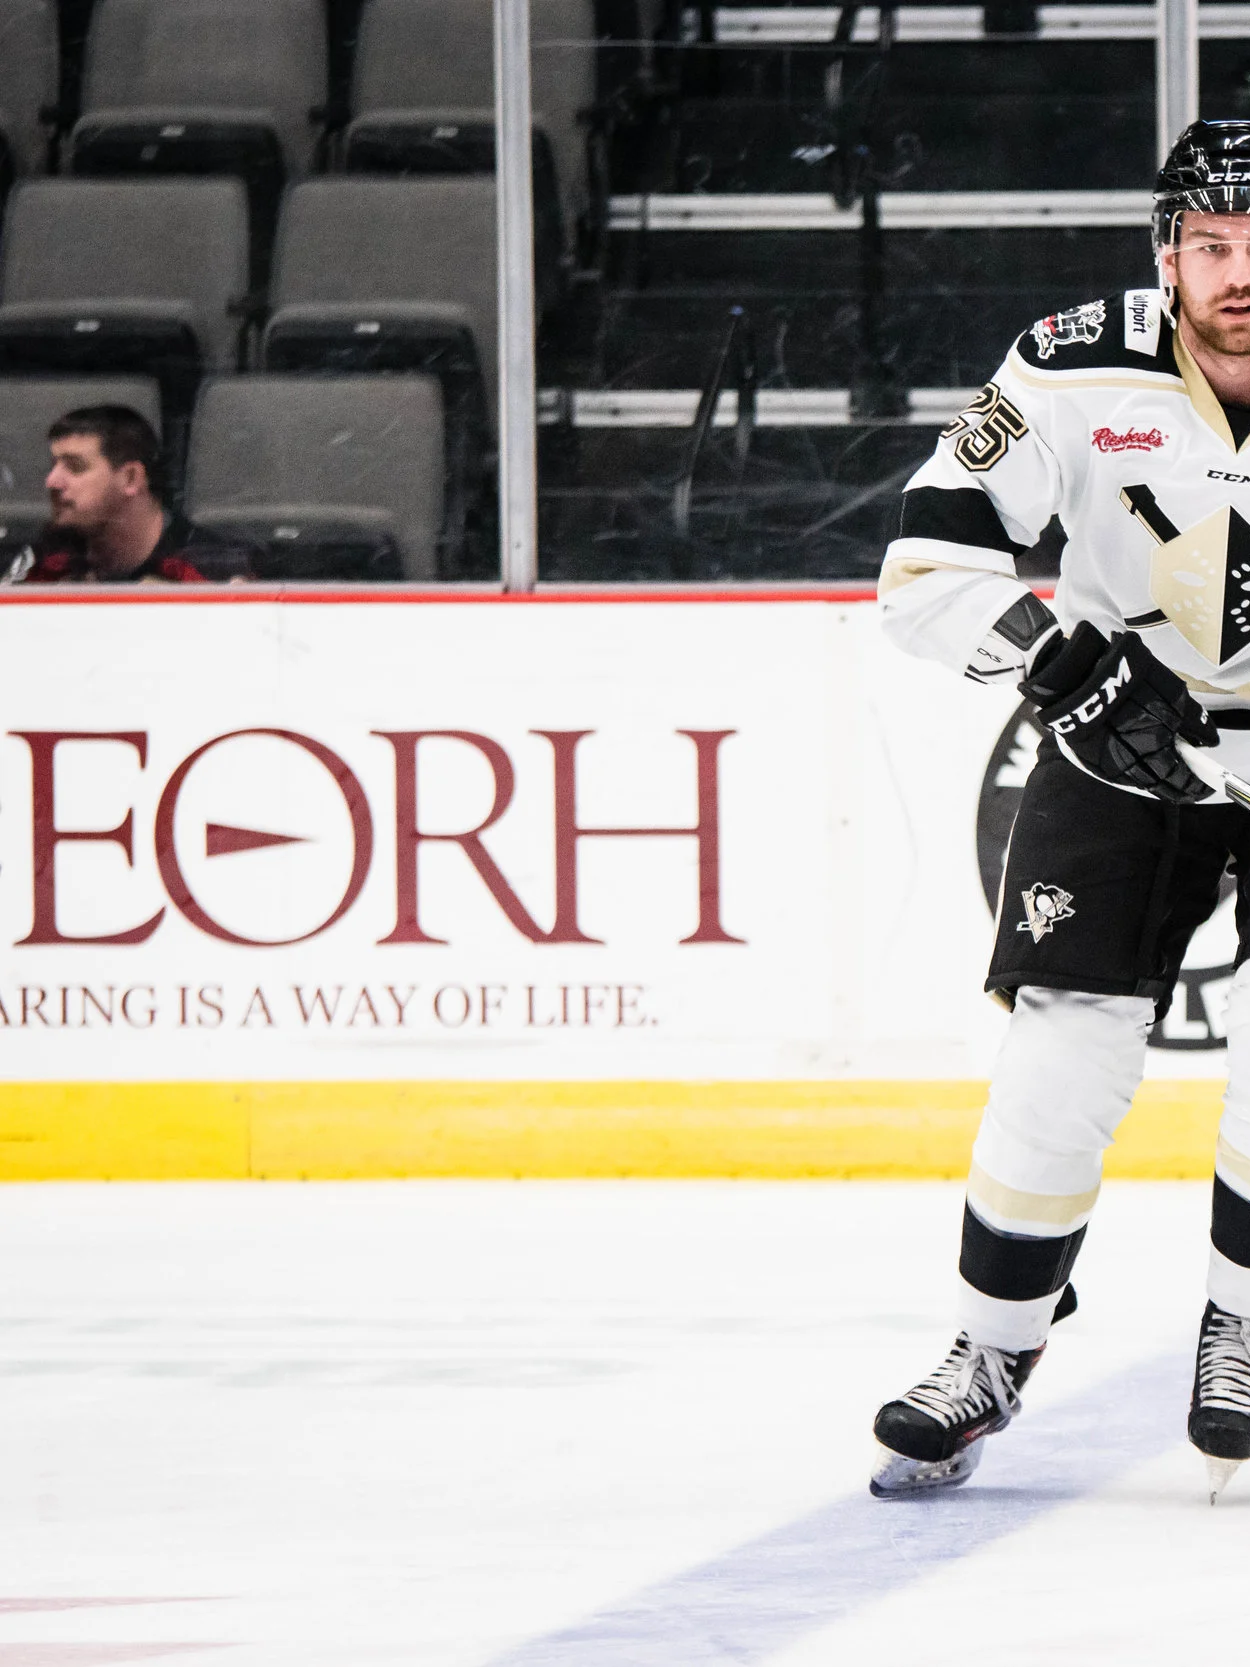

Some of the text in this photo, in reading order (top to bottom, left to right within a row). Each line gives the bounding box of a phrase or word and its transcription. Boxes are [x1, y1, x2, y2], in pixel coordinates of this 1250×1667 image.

[940, 382, 1029, 472] 25
[1048, 655, 1132, 734] CCM
[6, 727, 749, 948] EORH
[177, 986, 225, 1028] IS
[240, 986, 277, 1027] A
[293, 986, 418, 1028] WAY
[434, 985, 508, 1028] OF
[525, 985, 658, 1028] LIFE.
